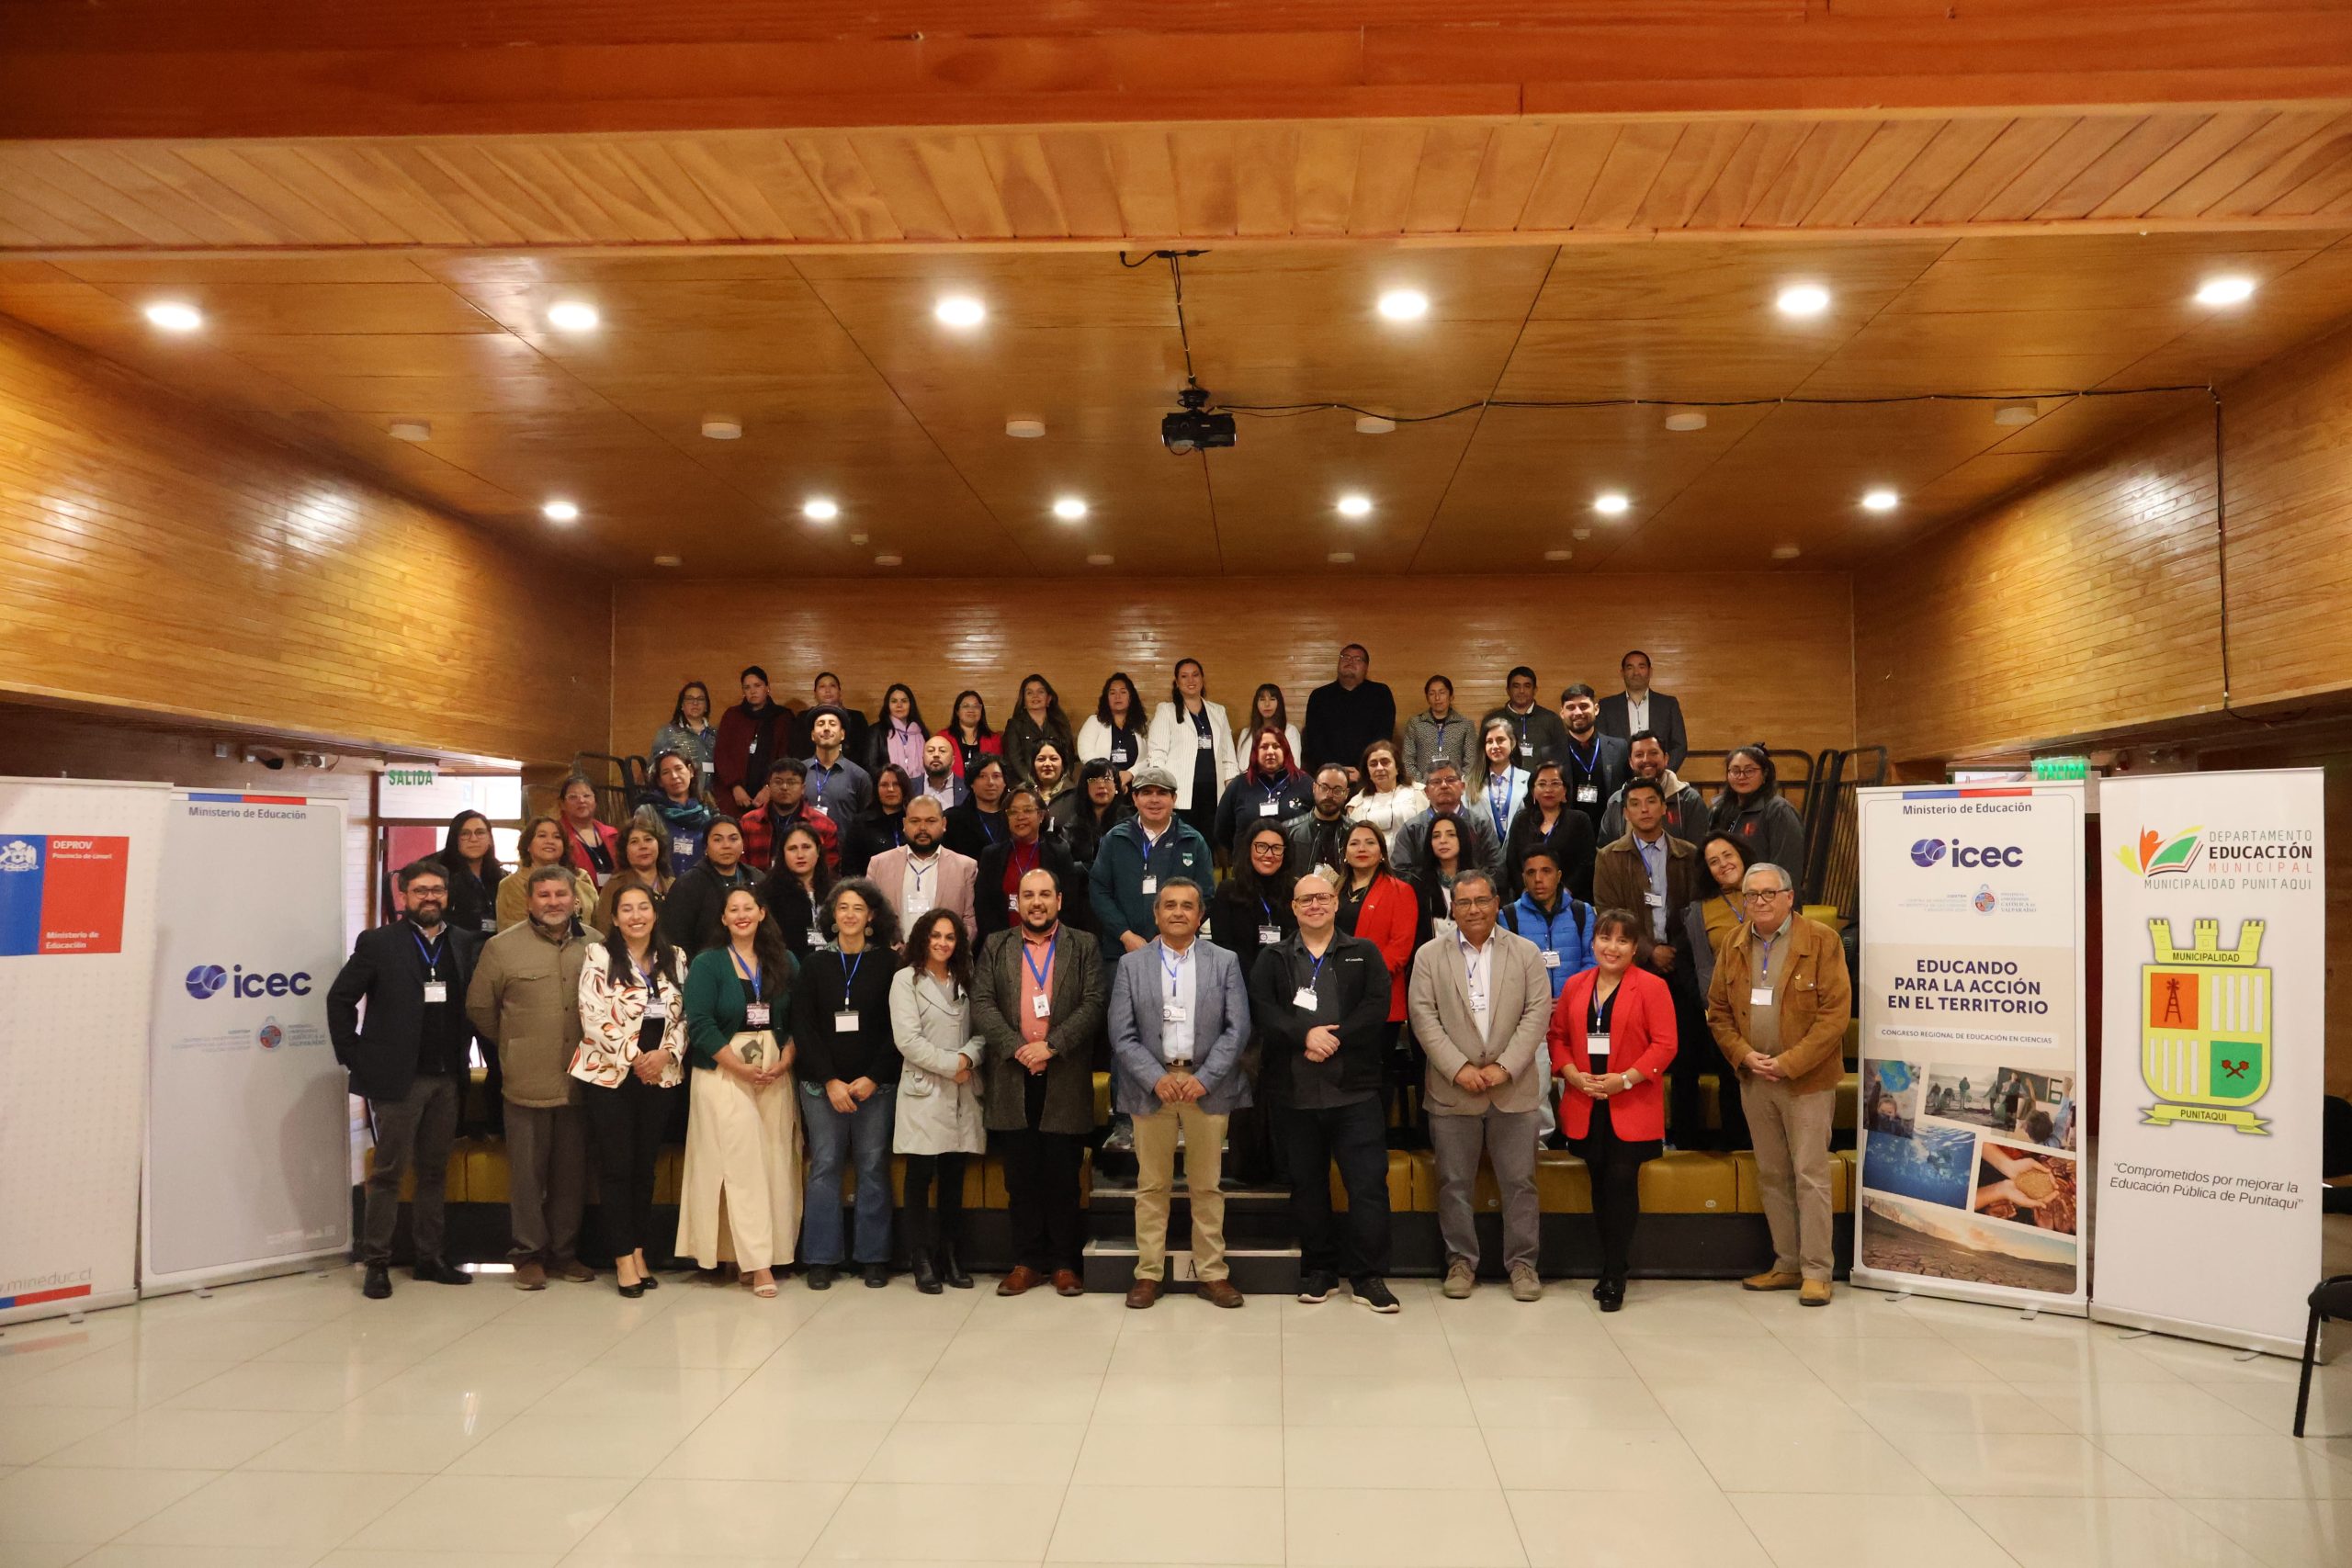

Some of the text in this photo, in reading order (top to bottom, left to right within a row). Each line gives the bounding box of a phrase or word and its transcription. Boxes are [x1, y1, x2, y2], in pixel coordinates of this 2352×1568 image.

[388, 770, 433, 785] SALIDA
[2038, 763, 2086, 779] SALIDA
[188, 807, 307, 819] Ministerio de Educación
[1903, 802, 2031, 815] Ministerio de Educación
[2210, 830, 2312, 842] DEPARTAMENTO
[52, 840, 93, 850] DEPROV
[1951, 838, 2023, 867] icec
[2209, 842, 2312, 859] EDUCACIÓN
[2209, 862, 2312, 874] MUNICIPAL
[2144, 878, 2312, 890] MUNICIPALIDAD PUNITAQUI
[2172, 952, 2240, 963] MUNICIPALIDAD
[1917, 959, 2018, 975] EDUCANDO
[233, 964, 312, 998] icec
[1894, 976, 2041, 995] PARA LA ACCIÓN
[1888, 995, 2048, 1014] EN EL TERRITORIO
[1881, 1029, 1919, 1037] CONGRESO
[1920, 1031, 1953, 1039] REGIONAL
[1966, 1033, 2007, 1042] EDUCACIÓN
[2180, 1109, 2227, 1121] PUNITAQUI
[2110, 1177, 2169, 1193] Educación
[2173, 1184, 2217, 1200] Pública
[2220, 1190, 2236, 1202] de
[2212, 1175, 2233, 1187] por
[2236, 1178, 2284, 1192] mejorar
[2287, 1181, 2299, 1193] la
[1186, 1258, 1197, 1278] A
